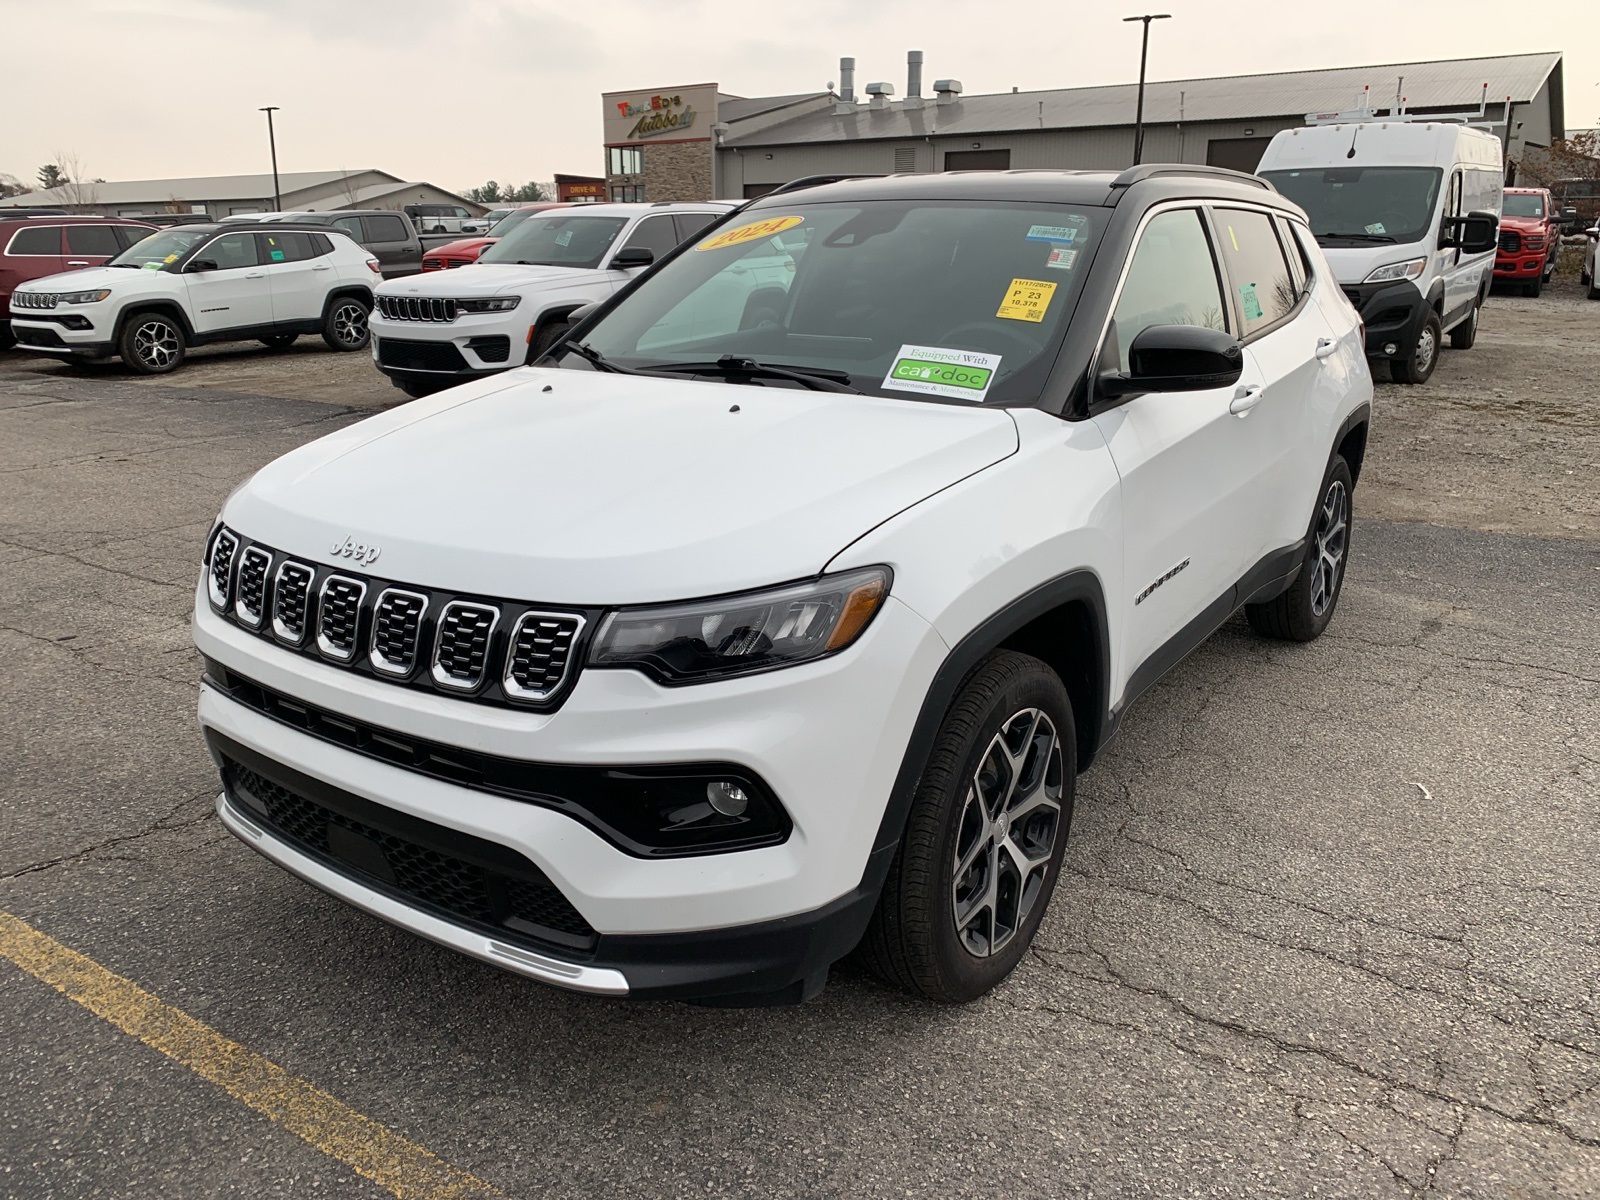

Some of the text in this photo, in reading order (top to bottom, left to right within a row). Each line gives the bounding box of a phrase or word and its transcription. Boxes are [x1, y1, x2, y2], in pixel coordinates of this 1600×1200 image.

[709, 218, 788, 247] 2024
[1014, 281, 1052, 289] 11/17/2025
[1028, 292, 1042, 300] 23
[910, 348, 988, 365] Equipped With
[888, 379, 929, 391] Maintenance
[939, 386, 982, 398] Membership
[329, 534, 381, 567] Jeep
[1135, 556, 1190, 606] COMPASS
